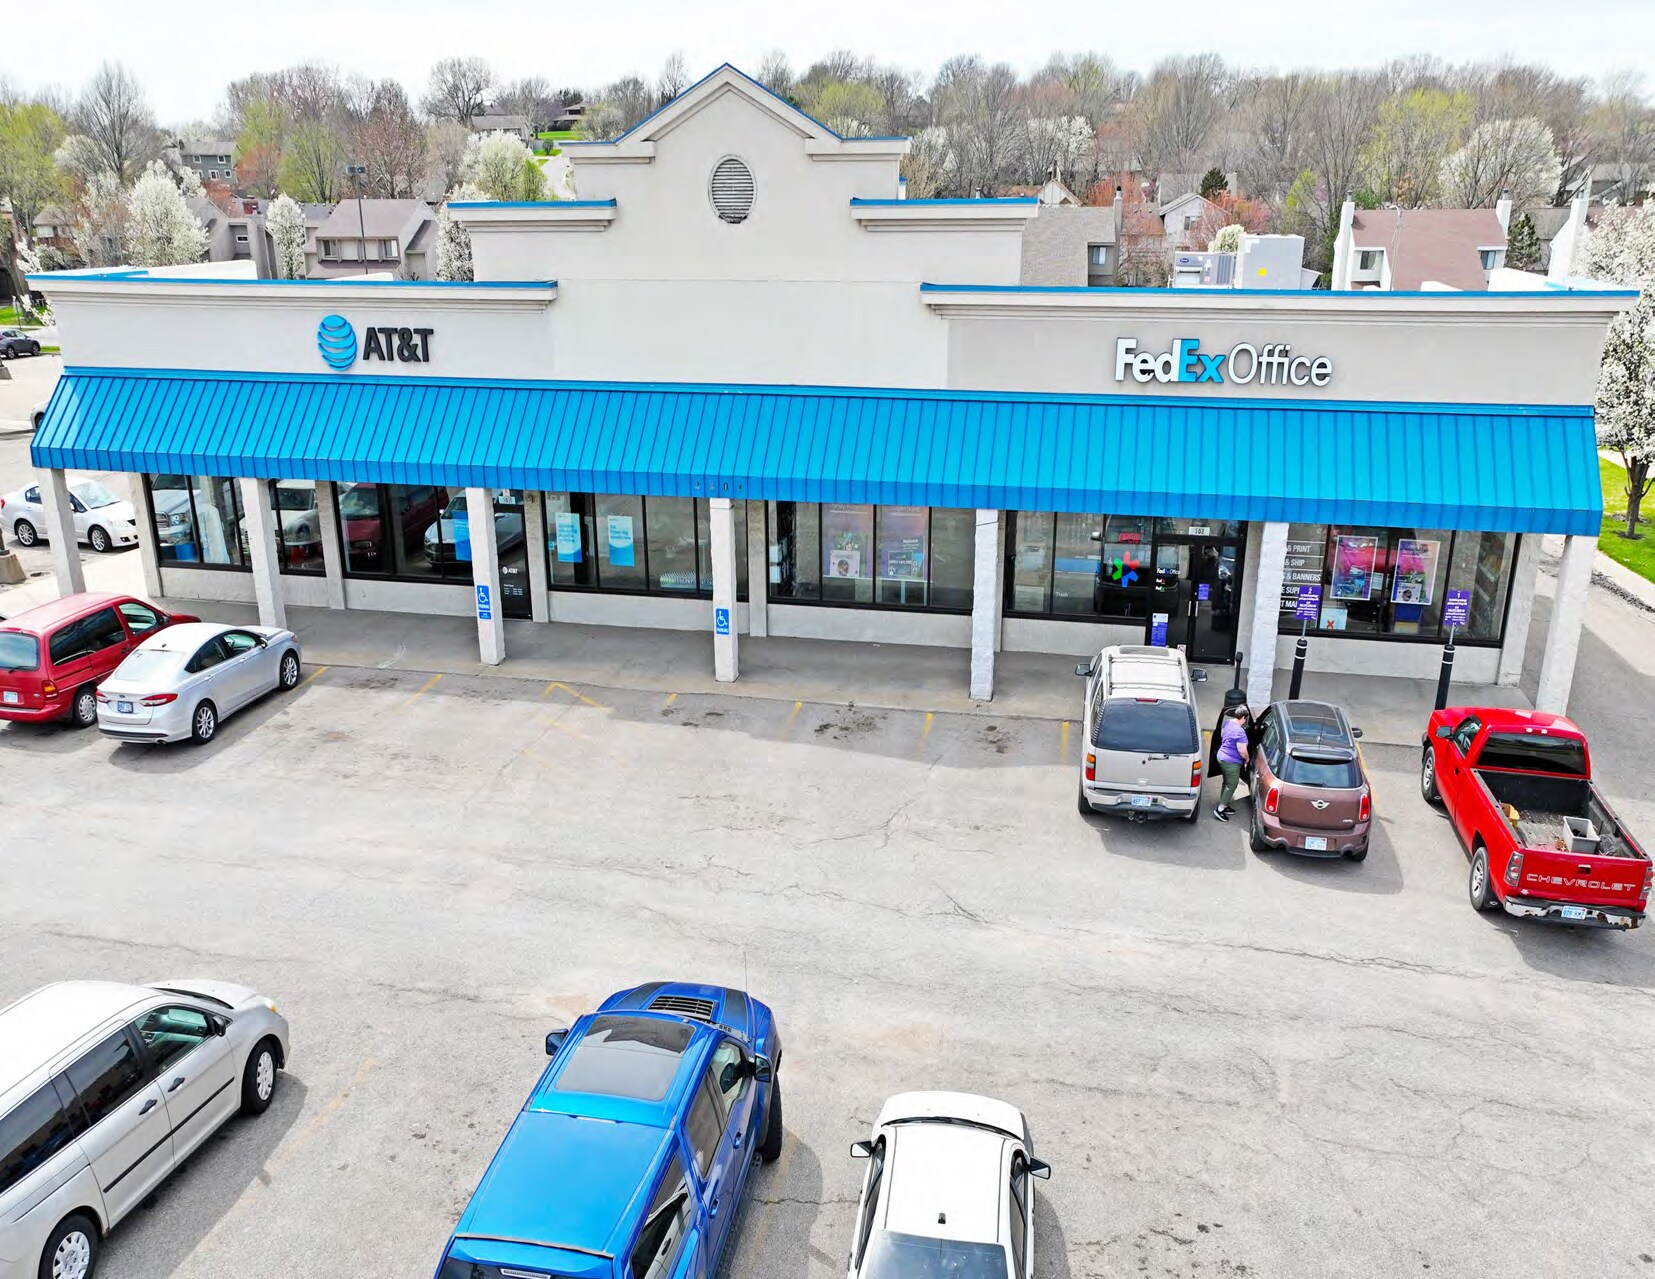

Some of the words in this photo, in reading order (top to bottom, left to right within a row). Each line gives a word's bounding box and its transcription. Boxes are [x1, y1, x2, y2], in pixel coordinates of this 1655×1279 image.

[362, 326, 434, 363] AT&T
[1114, 337, 1226, 384] FedEx
[1227, 341, 1333, 387] Office
[1118, 532, 1140, 543] OPEN
[1292, 545, 1311, 553] PRINT
[1290, 559, 1305, 567] SHIP
[1292, 572, 1321, 581] BANNERS
[1526, 873, 1636, 892] CHEVROLET
